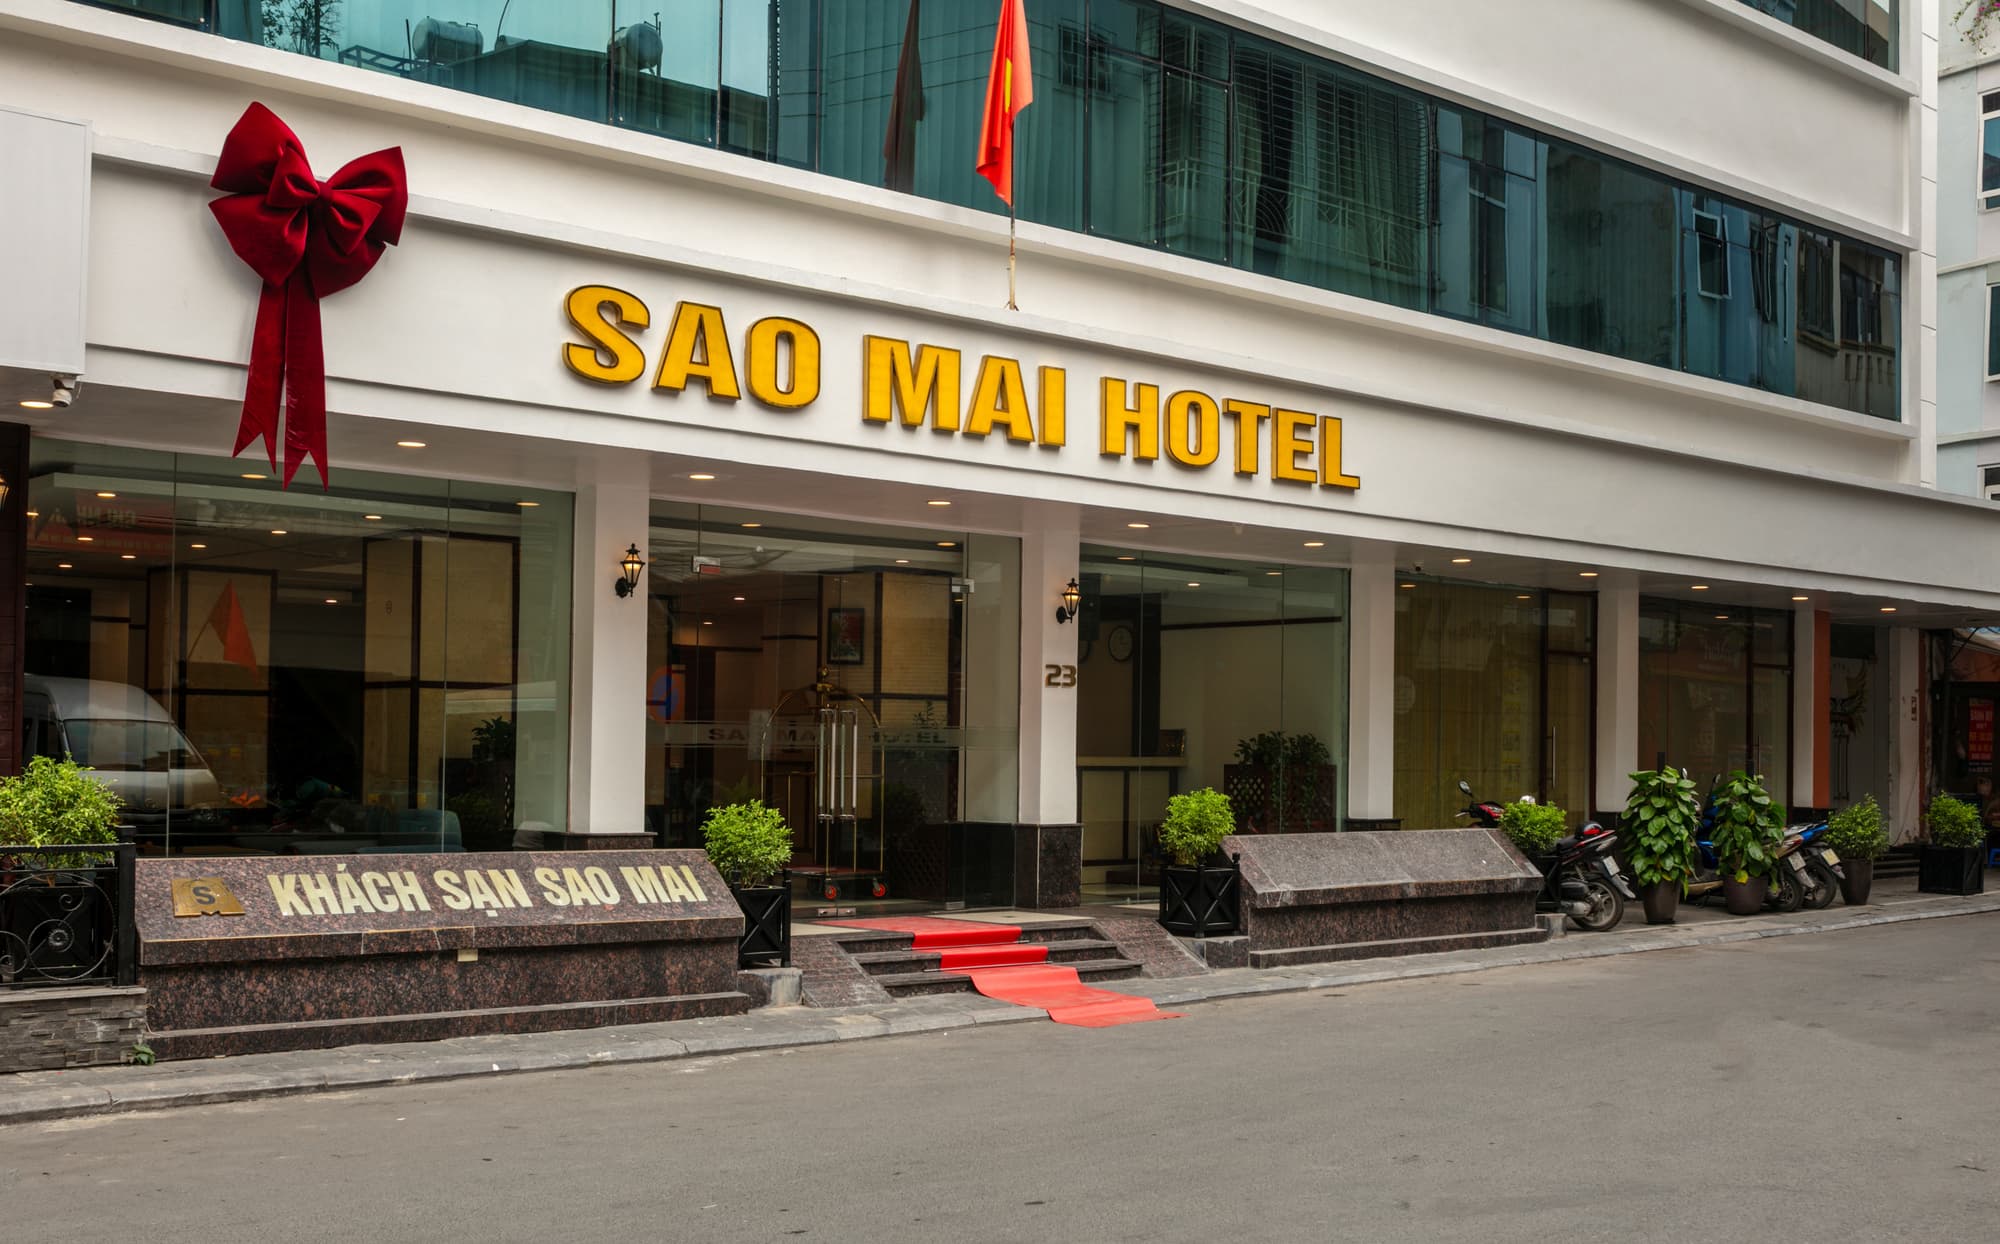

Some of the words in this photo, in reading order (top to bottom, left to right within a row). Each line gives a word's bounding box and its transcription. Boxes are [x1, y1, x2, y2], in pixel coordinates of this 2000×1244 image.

[563, 284, 821, 410] SAO
[862, 334, 1066, 448] MAI
[1100, 376, 1361, 490] HOTEL
[1045, 664, 1077, 687] 23
[192, 886, 216, 905] S
[266, 863, 432, 917] KHÁCH
[429, 868, 534, 917] SẠN
[534, 866, 621, 906] SAO
[619, 865, 709, 904] MAI
